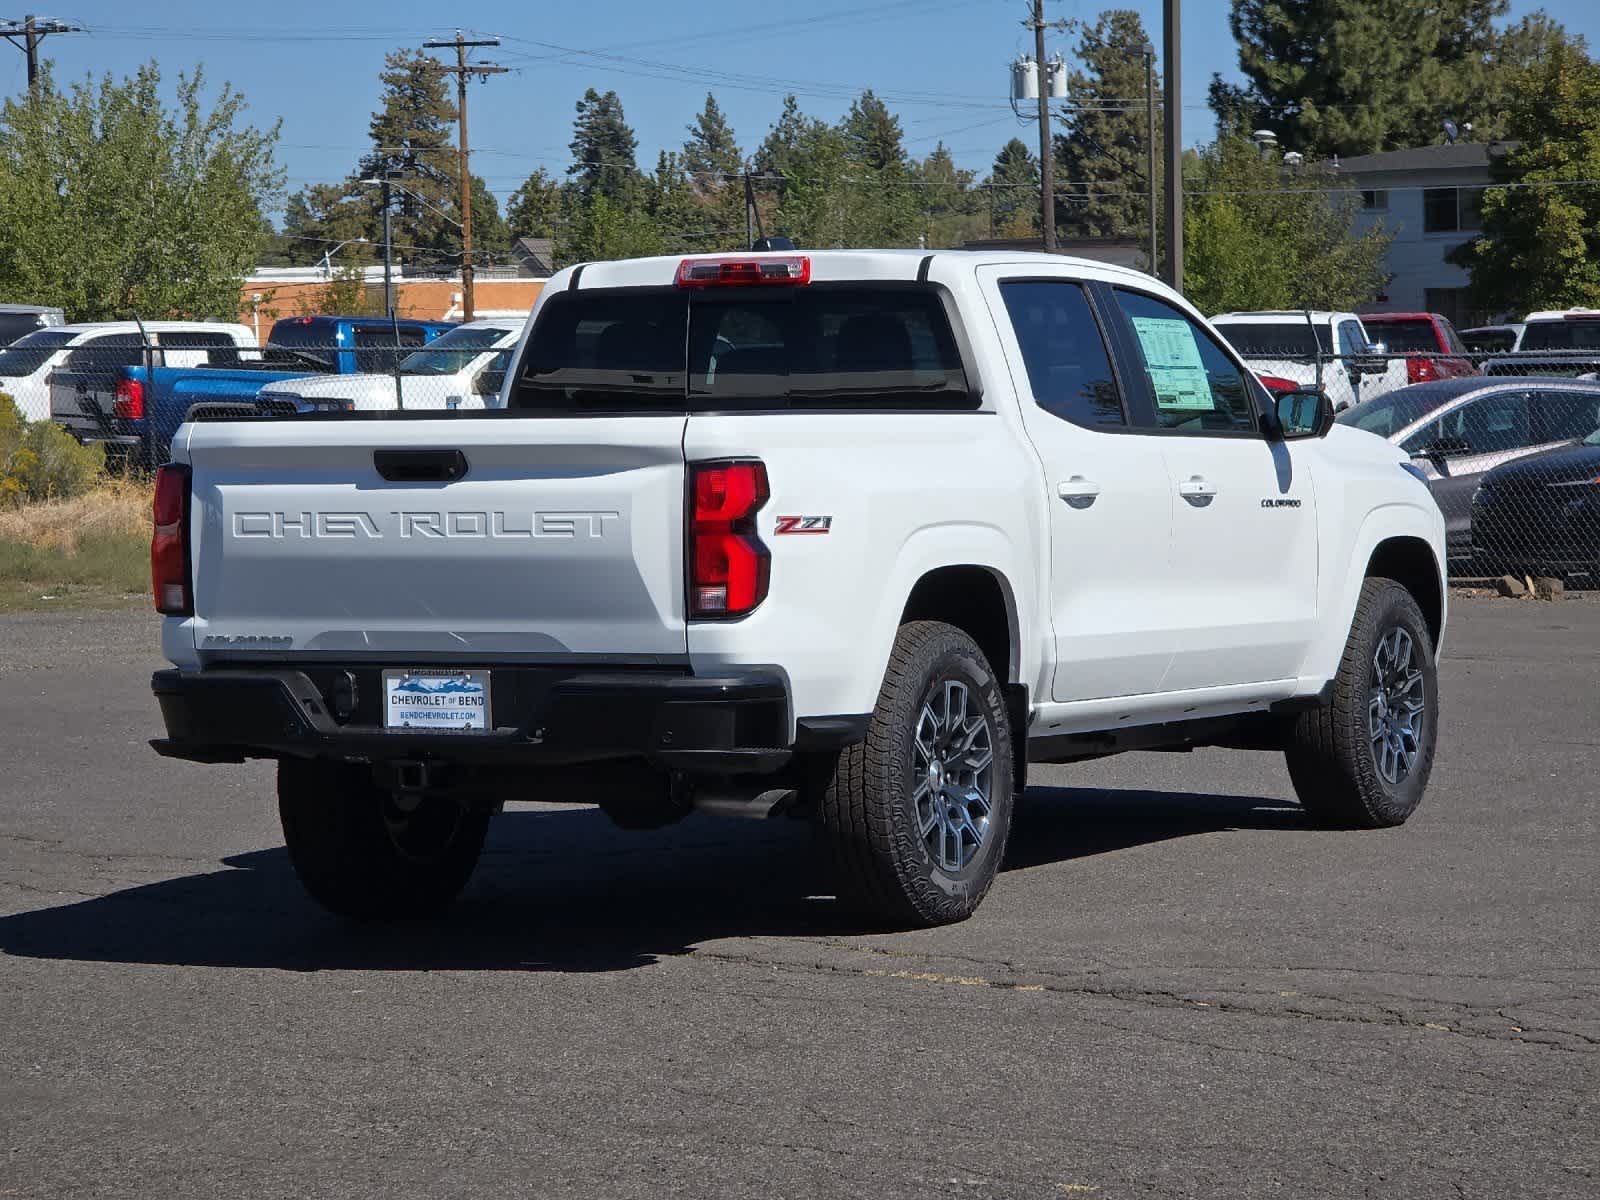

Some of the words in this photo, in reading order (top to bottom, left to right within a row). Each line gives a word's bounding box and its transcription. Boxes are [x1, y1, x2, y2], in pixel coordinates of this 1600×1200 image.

[1260, 499, 1302, 508] COLORADO
[232, 511, 619, 539] CHEVROLET
[774, 515, 833, 536] Z71
[391, 695, 447, 706] CHEVROLET
[458, 695, 485, 706] BEND
[400, 711, 476, 720] BENDCHEVROLET.COM
